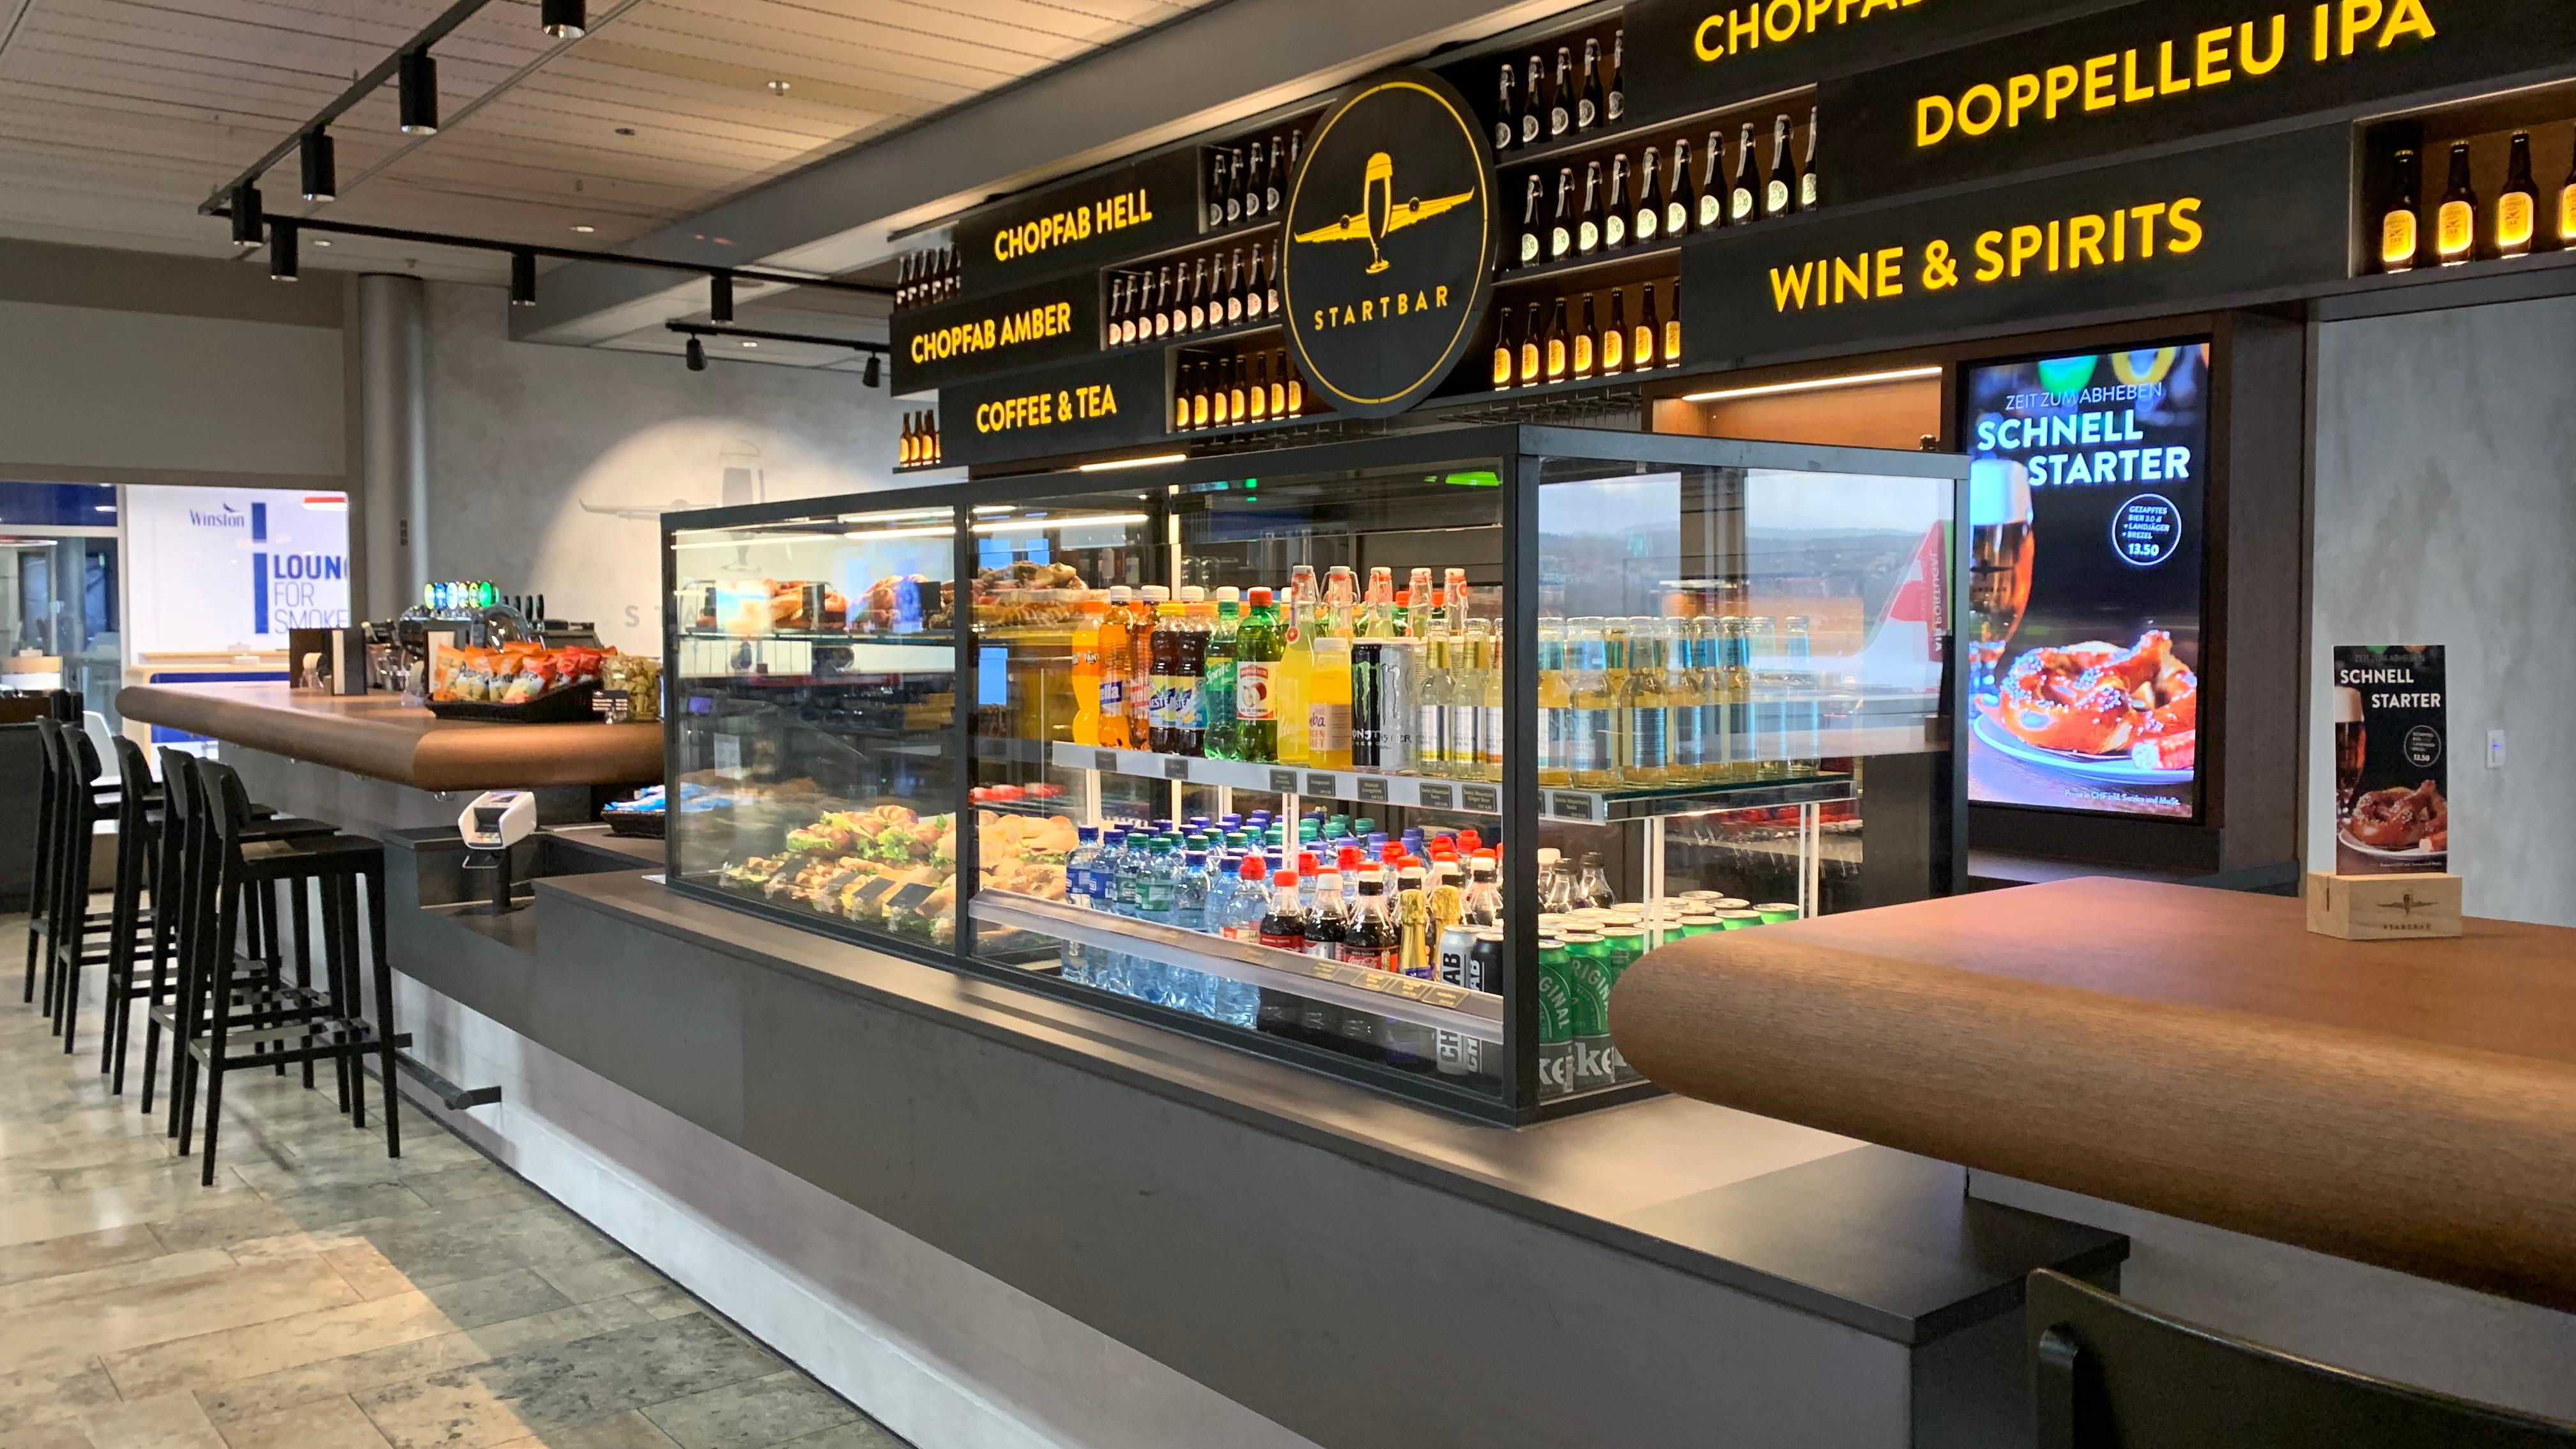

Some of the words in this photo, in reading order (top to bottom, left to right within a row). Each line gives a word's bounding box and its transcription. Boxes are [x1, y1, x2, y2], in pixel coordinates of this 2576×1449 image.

[1695, 0, 1920, 61] CHOPF
[1917, 14, 2285, 146] DOPPELLEU
[2315, 0, 2435, 61] IPA
[995, 207, 1091, 261] CHOPFAB
[1097, 189, 1152, 233] HELL
[1770, 247, 1903, 312] WINE
[1922, 240, 1958, 289] &
[1975, 198, 2202, 282] SPIRITS
[1314, 286, 1448, 330] STARTBAR
[912, 319, 995, 364] CHOPFAB
[1000, 302, 1071, 345] AMBER
[977, 394, 1052, 433] COFFEE
[1058, 391, 1073, 421] &
[1076, 385, 1117, 418] TEA
[2005, 393, 2037, 411] ZEIT
[2041, 391, 2076, 407] ZUM
[2079, 382, 2162, 404] ABHEBEN
[1977, 410, 2143, 451] SCHNELL
[2028, 446, 2191, 486] STARTER
[190, 509, 245, 527] Winston
[2129, 506, 2167, 514] GEZAPFTES
[2128, 543, 2159, 556] 13.50
[275, 582, 314, 608] FOR
[1206, 663, 1231, 686] Sprite
[2340, 669, 2414, 684] SCHNELL
[1100, 684, 1119, 701] ella
[2372, 693, 2441, 708] STARTER
[2122, 793, 2145, 802] Service
